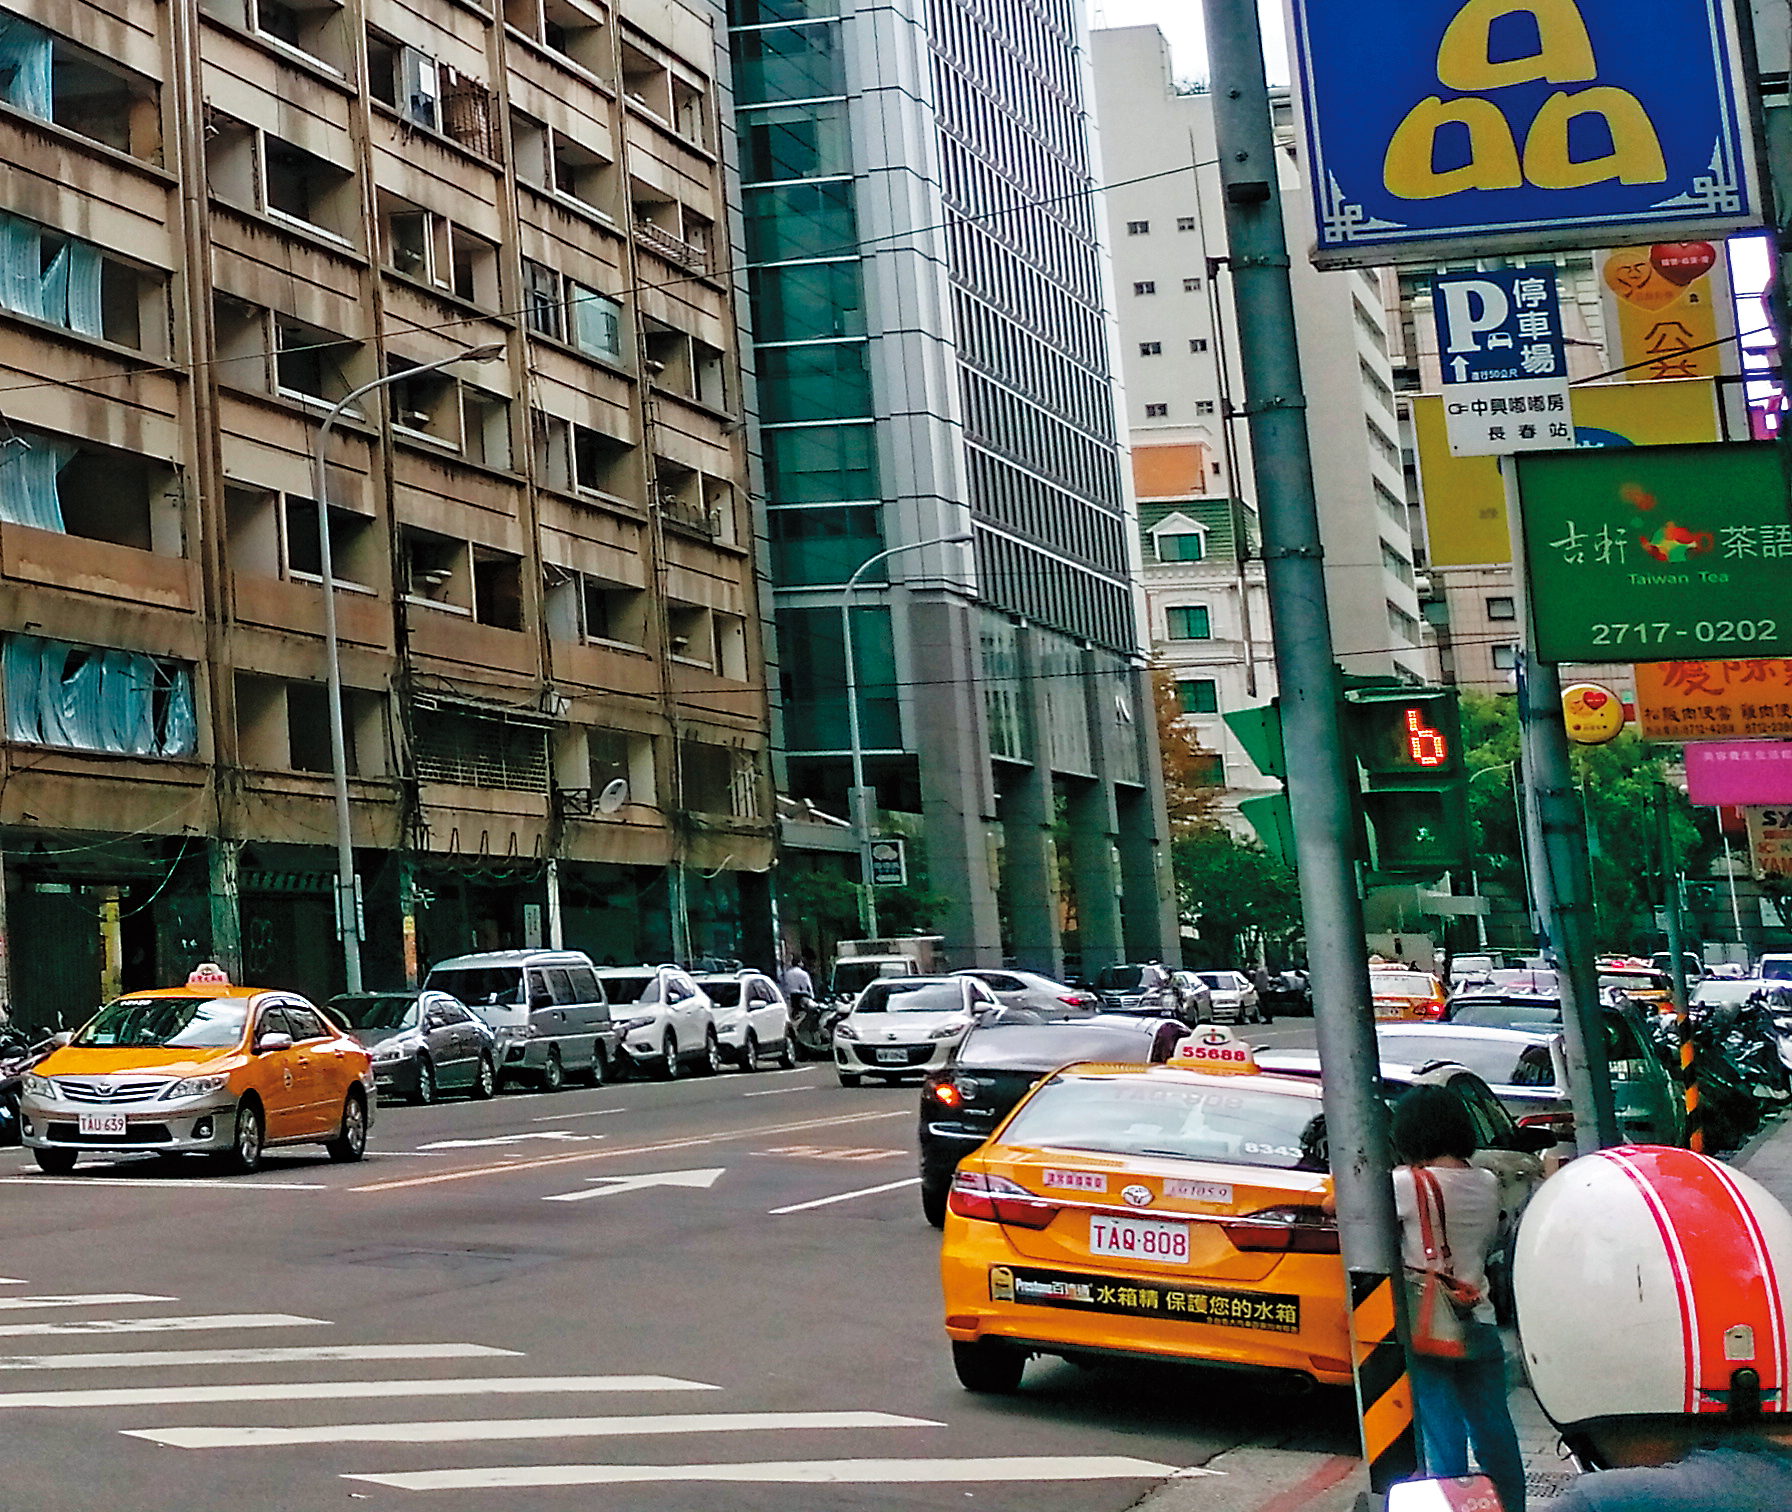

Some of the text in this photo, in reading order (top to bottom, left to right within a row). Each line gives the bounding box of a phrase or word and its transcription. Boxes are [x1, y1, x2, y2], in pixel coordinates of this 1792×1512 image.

[1439, 279, 1509, 354] P
[1512, 276, 1556, 375] 停車場
[1488, 421, 1568, 442] 長春站
[1627, 571, 1730, 586] Taiwan Tea
[1590, 619, 1779, 645] 2717-0202
[1182, 1046, 1246, 1062] 55688
[1244, 1141, 1304, 1159] 8343
[1097, 1284, 1160, 1310] 水箱精
[1165, 1291, 1297, 1324] 保護您的水箱
